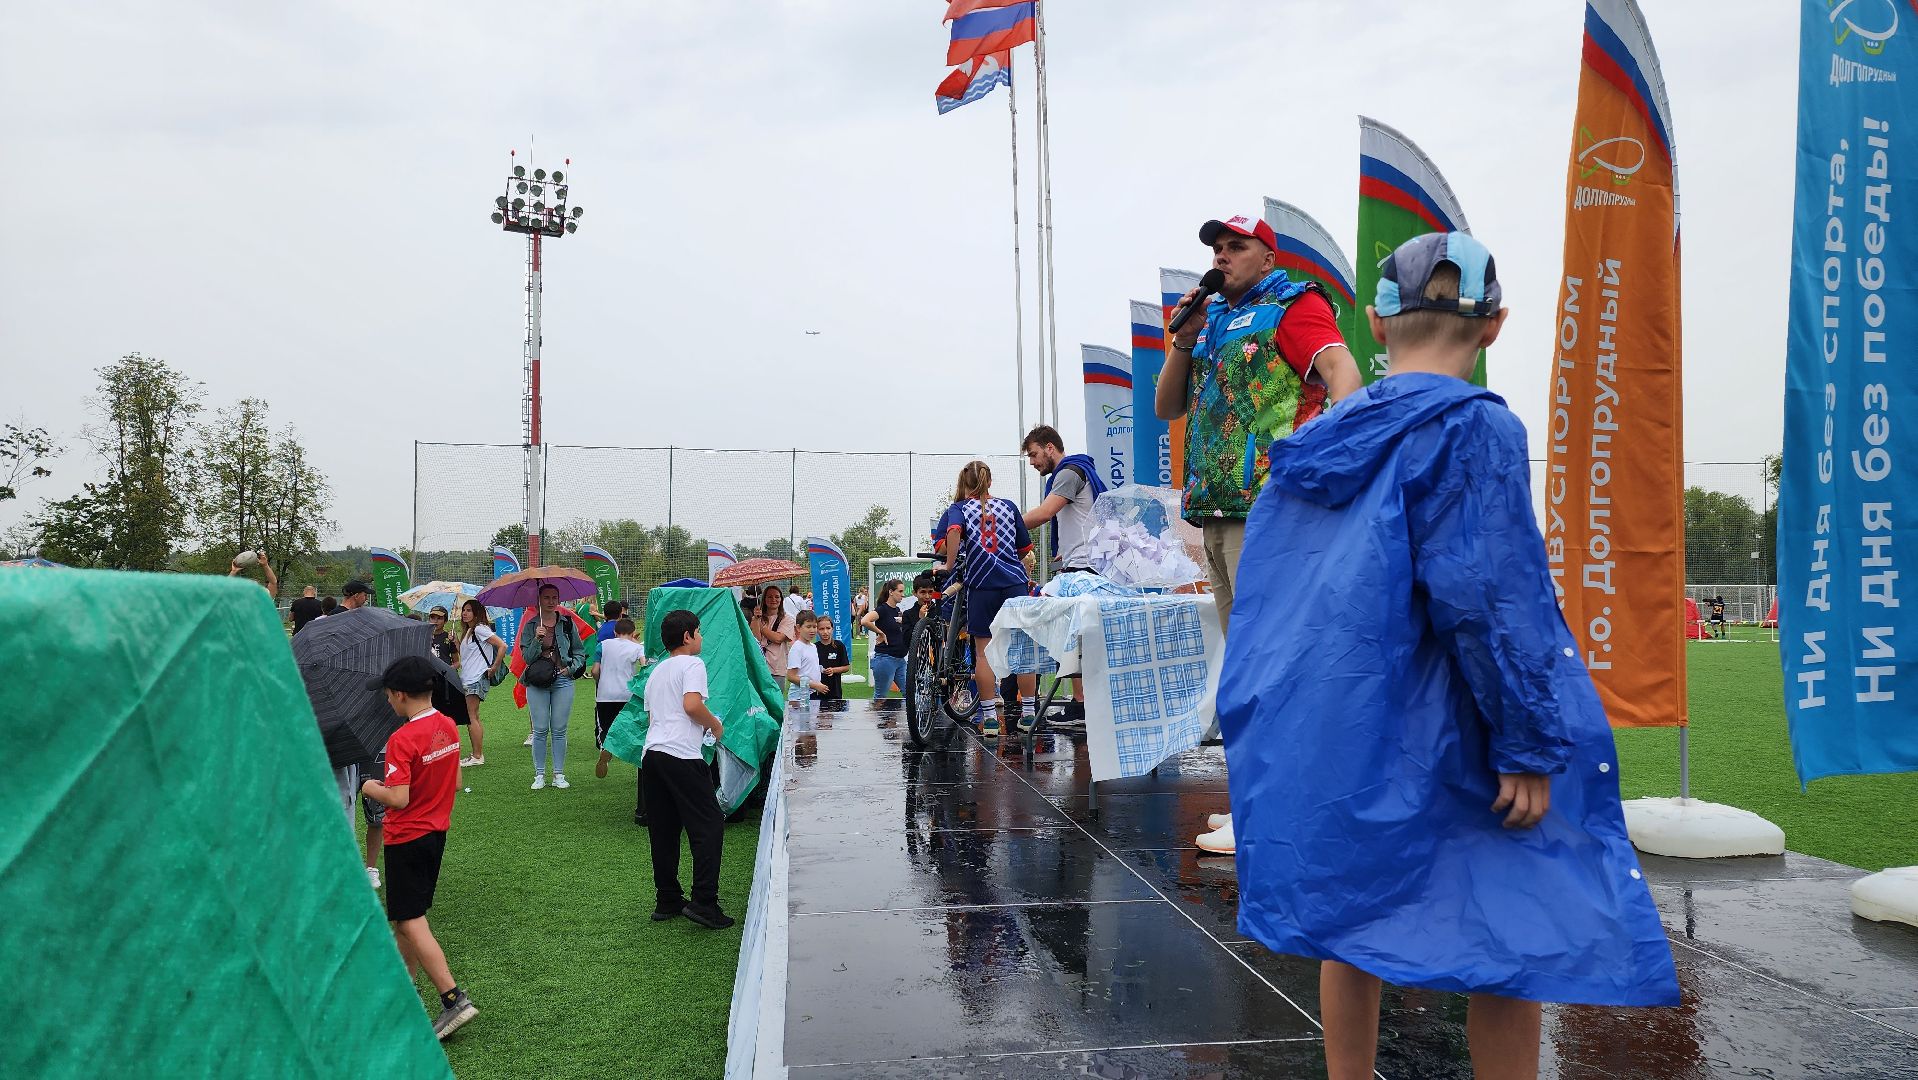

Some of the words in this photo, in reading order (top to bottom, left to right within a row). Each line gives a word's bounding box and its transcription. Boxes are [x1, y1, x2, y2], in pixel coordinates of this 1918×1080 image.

[1829, 53, 1897, 88] ДОЛГОПРУДНЫЙ
[1823, 138, 1850, 364] спорта,
[1856, 116, 1893, 363] победы!
[1583, 258, 1622, 595] Долгопрудный
[1817, 382, 1836, 484] без
[1851, 383, 1890, 482] без
[1805, 504, 1831, 612] дня
[1861, 502, 1900, 608] дня
[1797, 630, 1826, 709] Ни
[1854, 626, 1897, 703] Ни
